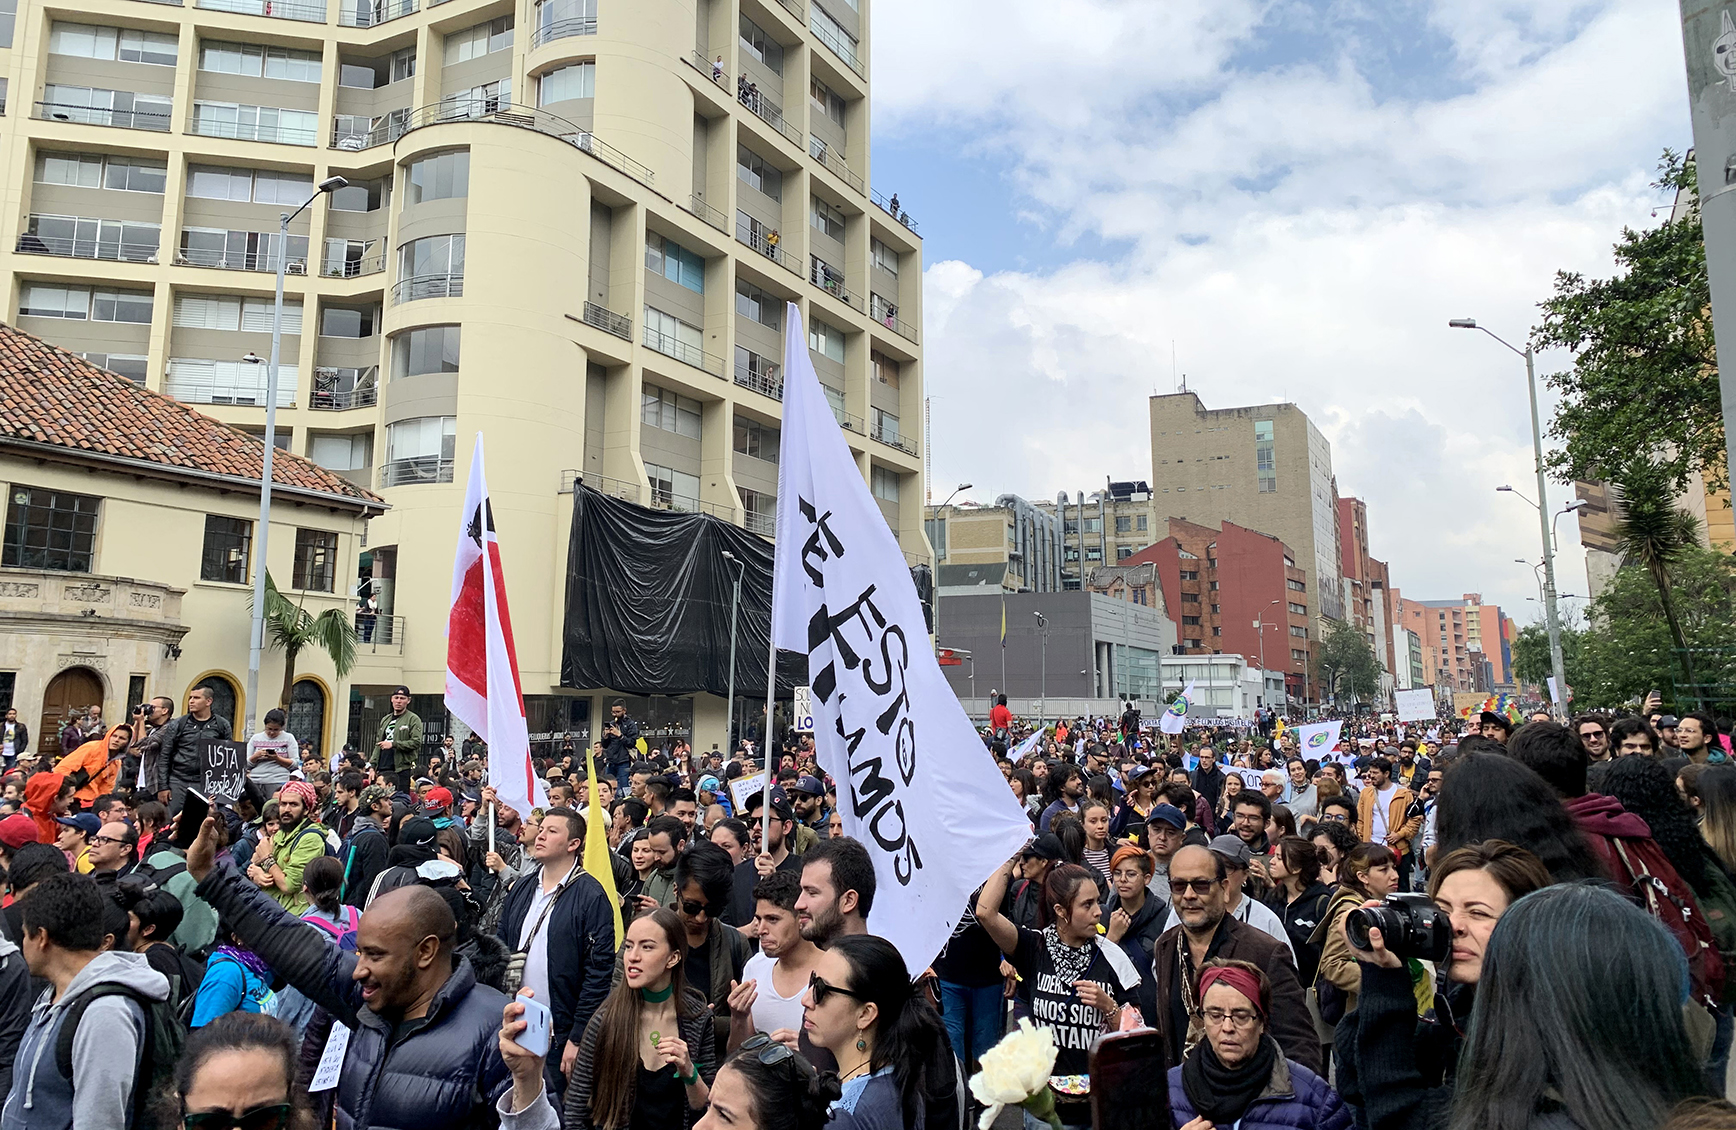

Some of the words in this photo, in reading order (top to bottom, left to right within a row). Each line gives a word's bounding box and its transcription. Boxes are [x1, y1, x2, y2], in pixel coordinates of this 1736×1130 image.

[208, 744, 239, 770] USTA
[1037, 971, 1071, 996] LIDER
[1033, 997, 1067, 1022] #NOS
[1070, 1003, 1101, 1027] SIGU
[1035, 1018, 1100, 1051] ATAN
